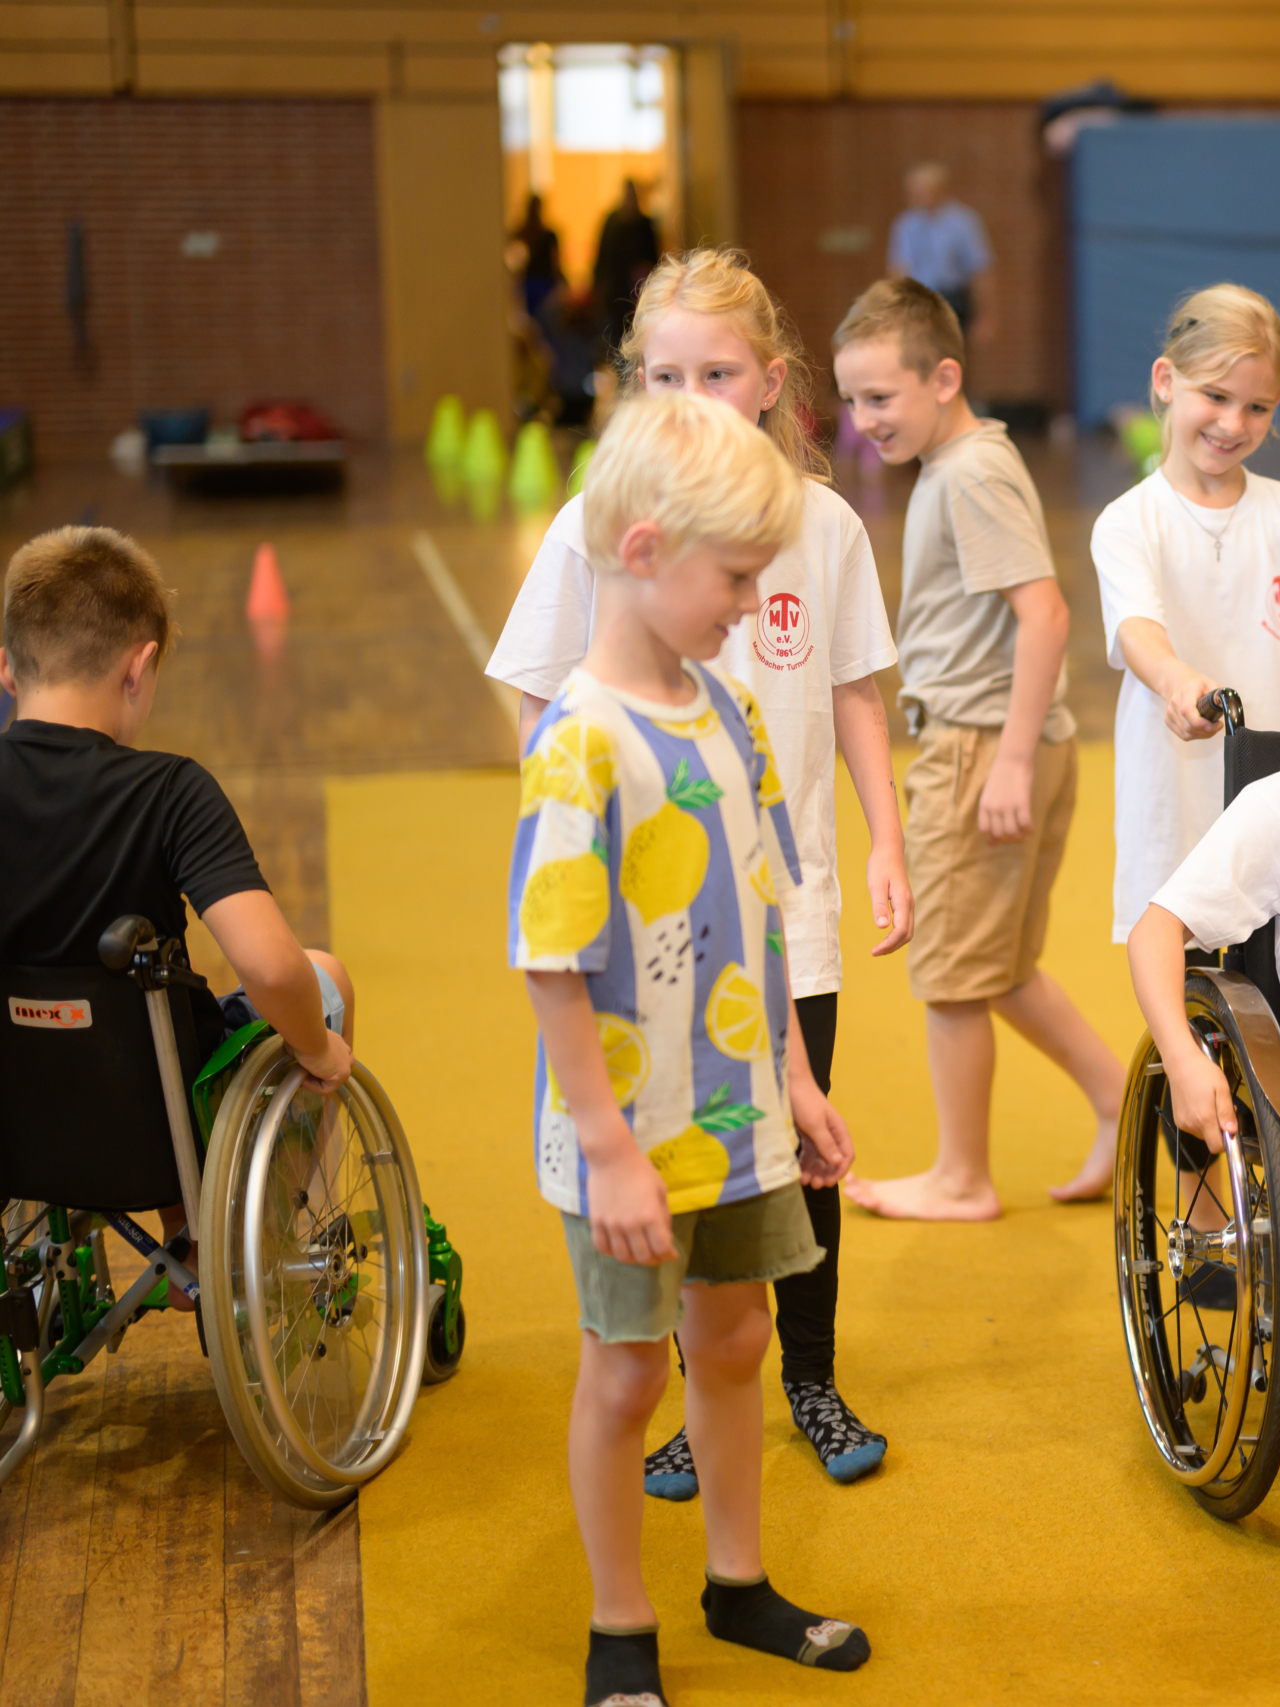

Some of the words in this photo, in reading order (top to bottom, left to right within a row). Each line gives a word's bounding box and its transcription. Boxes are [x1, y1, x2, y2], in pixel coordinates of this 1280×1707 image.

[768, 592, 800, 631] MTV
[776, 634, 793, 644] e.V.
[752, 641, 785, 671] Mombacher
[786, 644, 815, 671] Turnverein
[776, 648, 793, 658] 1861
